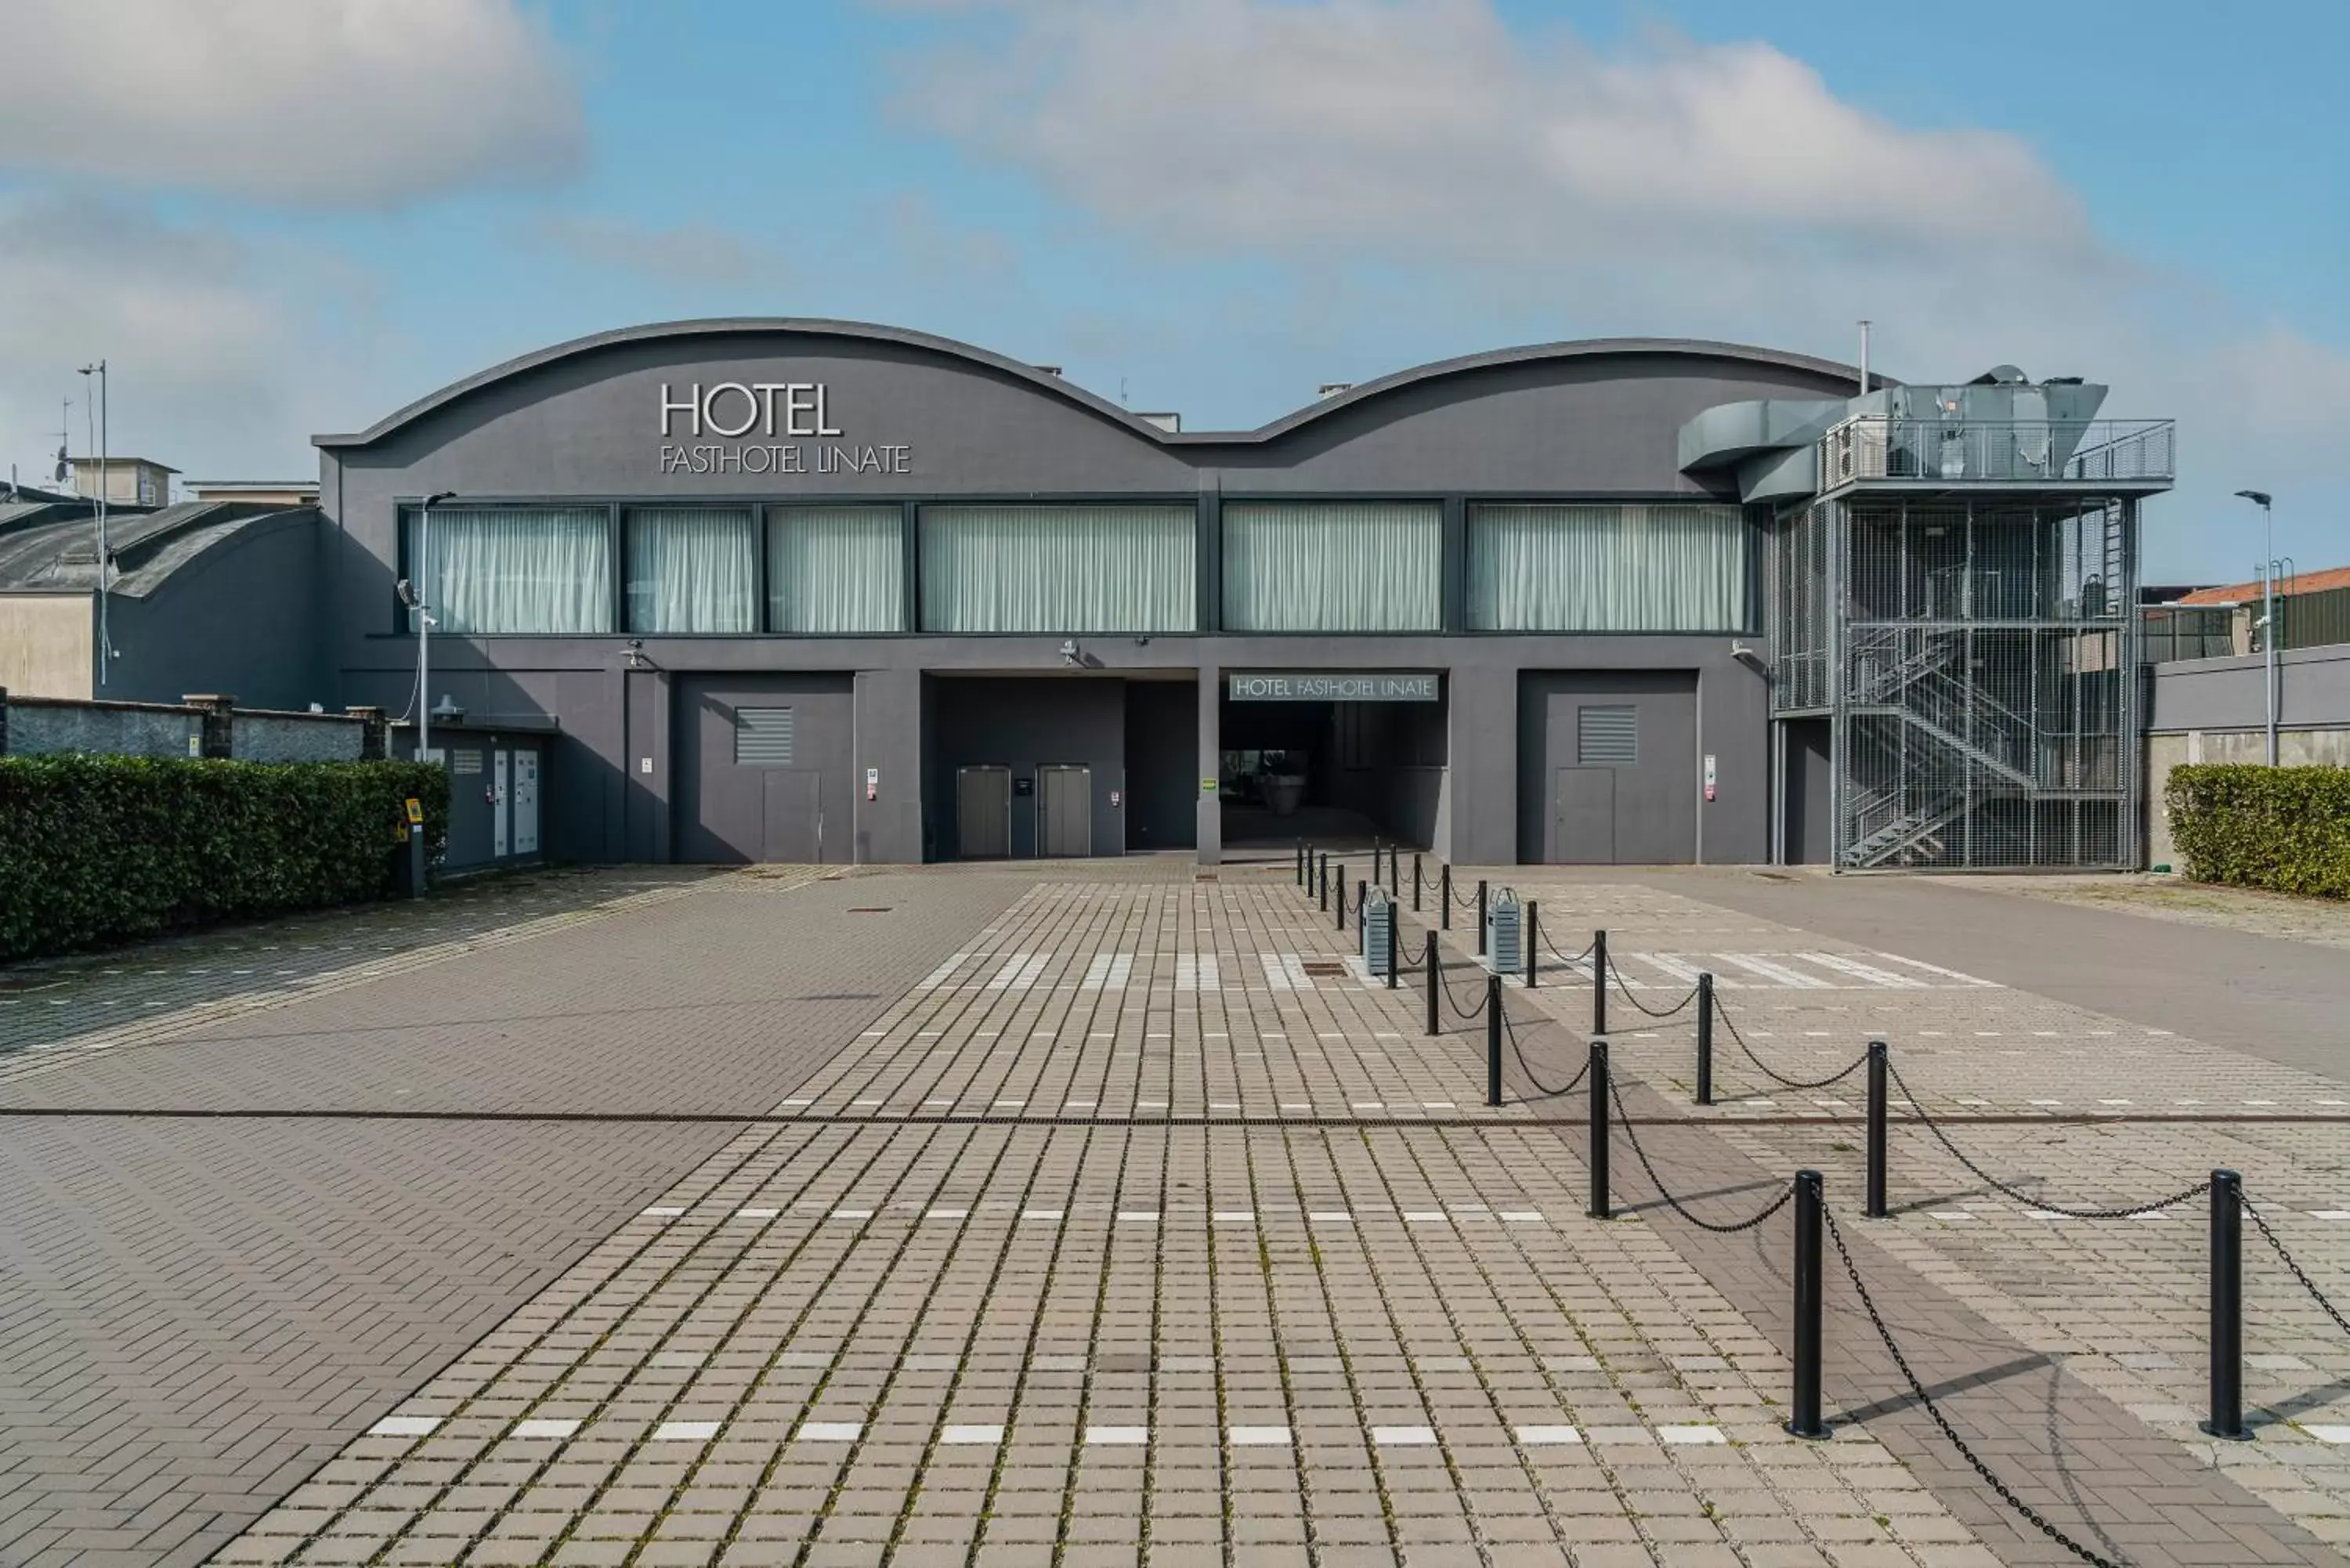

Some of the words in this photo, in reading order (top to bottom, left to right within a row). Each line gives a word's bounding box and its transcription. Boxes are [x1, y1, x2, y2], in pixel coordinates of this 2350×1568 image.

[661, 381, 841, 436] HOTEL
[660, 445, 807, 473] FASTHOTEL
[818, 445, 911, 473] LINATE
[1236, 679, 1292, 696] HOTEL
[1296, 679, 1376, 696] FASTHOTEL
[1380, 679, 1432, 696] LINATE
